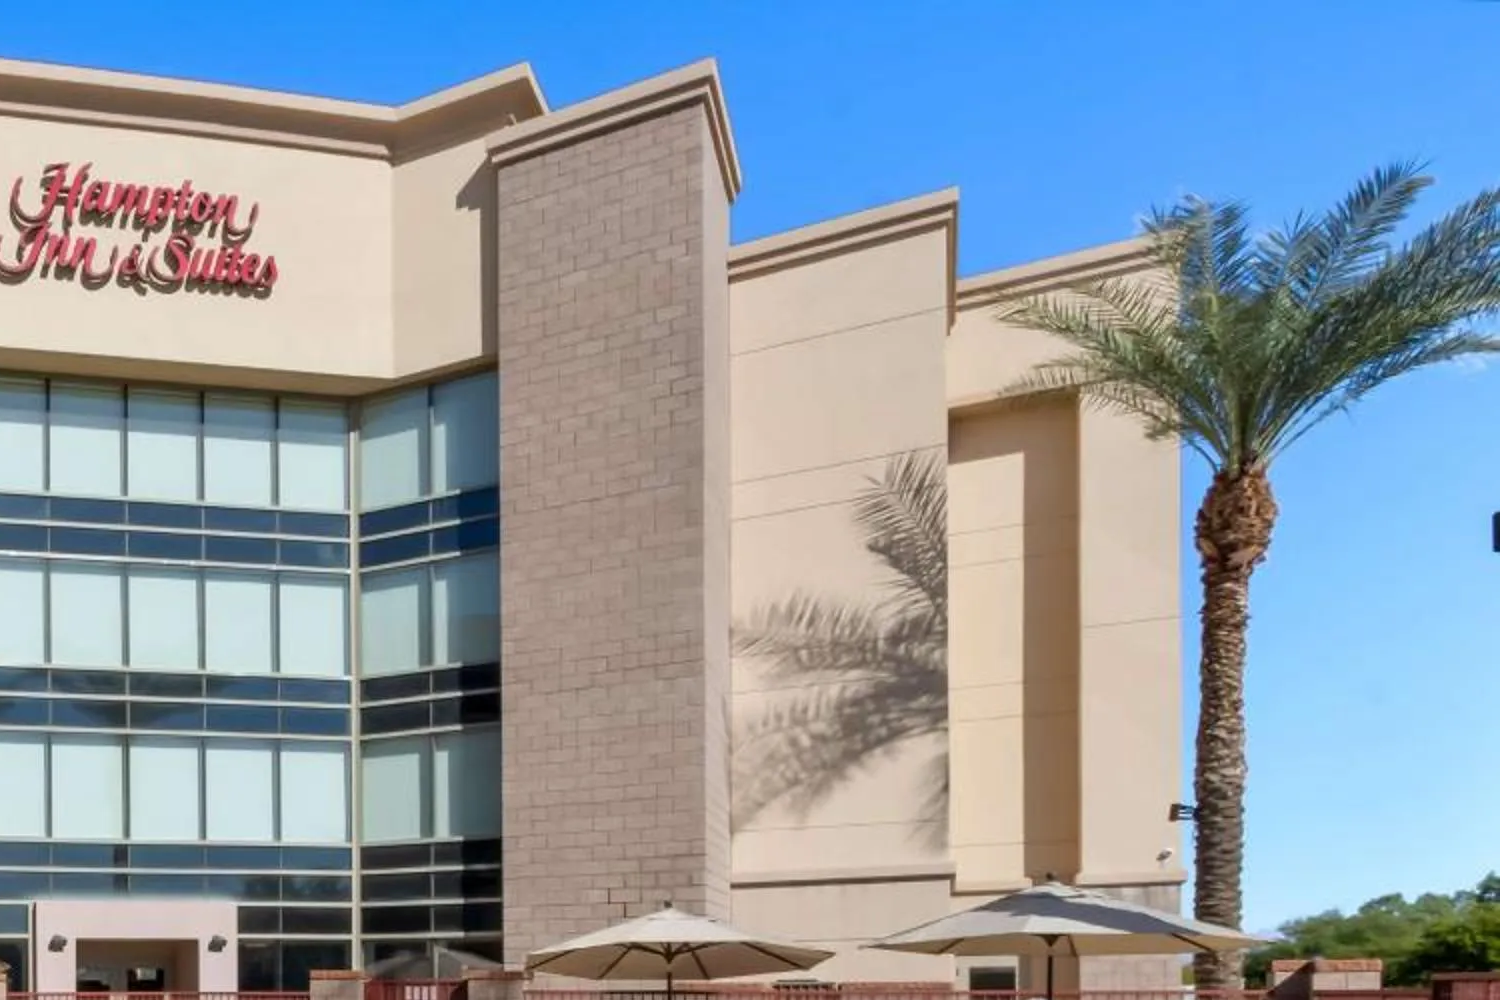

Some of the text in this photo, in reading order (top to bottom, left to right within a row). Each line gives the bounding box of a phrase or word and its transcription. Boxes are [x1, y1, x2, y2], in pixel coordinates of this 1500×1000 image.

[10, 162, 259, 236] Hampton
[116, 245, 151, 283] &
[149, 232, 278, 288] Suites
